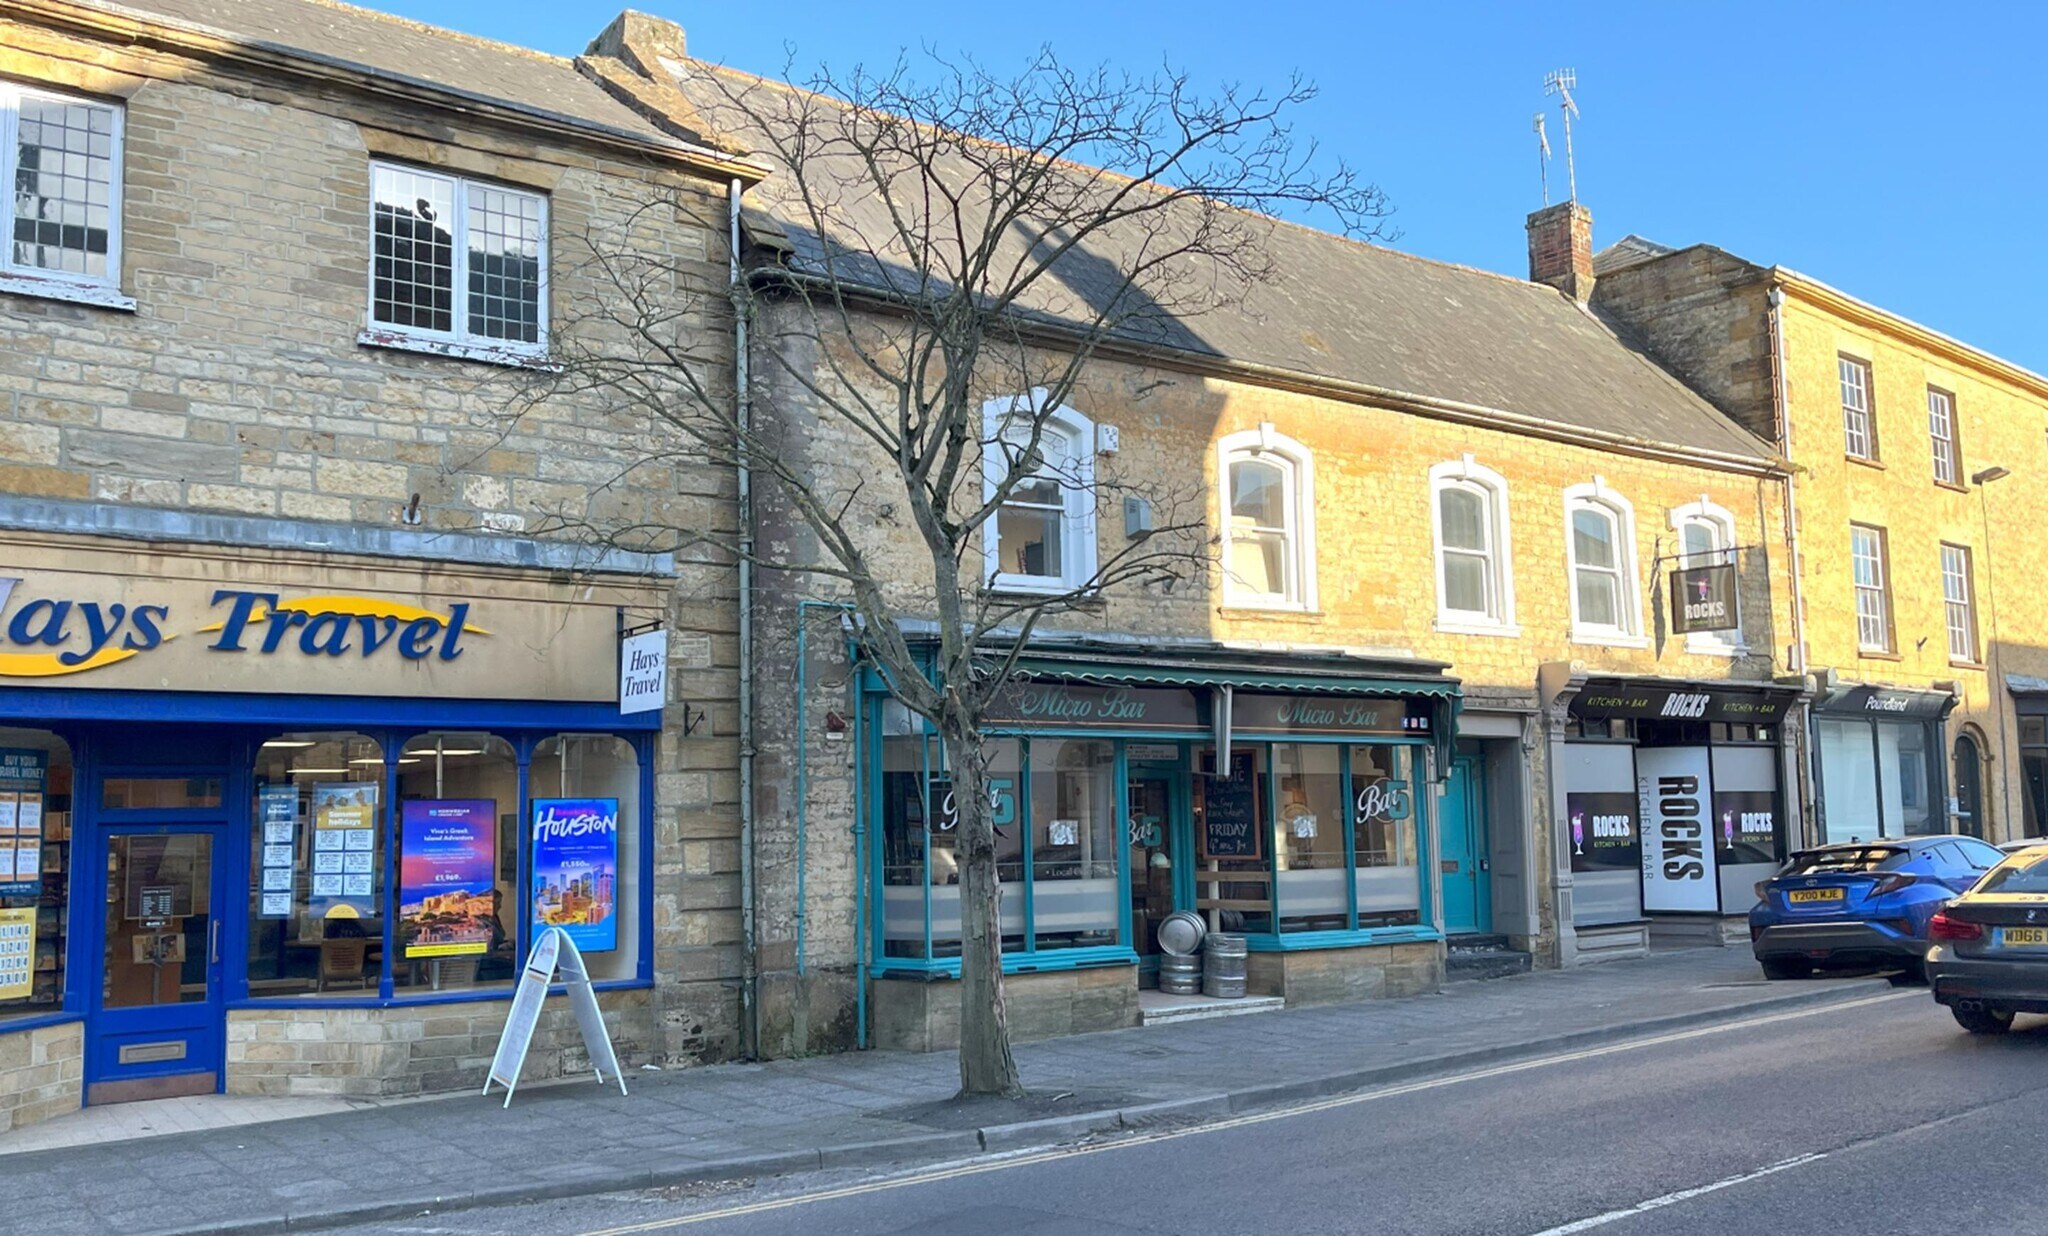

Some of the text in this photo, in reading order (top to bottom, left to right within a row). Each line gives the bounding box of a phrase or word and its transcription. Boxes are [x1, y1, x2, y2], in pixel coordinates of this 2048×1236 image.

[1684, 601, 1725, 620] ROCKS
[207, 589, 470, 662] Travel
[630, 649, 660, 673] Hays
[624, 671, 662, 697] Travel
[1020, 687, 1147, 719] Micro Bar
[1277, 699, 1380, 726] Micro Bar
[1586, 696, 1624, 707] KITCHEN
[1631, 698, 1649, 708] BAR
[1660, 692, 1711, 718] ROCKS
[1722, 702, 1754, 713] KITCHEN
[1760, 704, 1776, 713] BAR
[1865, 695, 1910, 712] Poundland
[1355, 780, 1410, 824] Bar 5
[1638, 776, 1651, 836] KITCHEN
[328, 817, 361, 827] holidays
[1142, 815, 1162, 847] 5
[1209, 823, 1248, 837] FRIDAY
[1592, 815, 1630, 838] ROCKS
[1657, 775, 1705, 881] ROCKS
[1741, 812, 1773, 833] ROCKS
[1643, 854, 1654, 880] BAR
[1793, 890, 1818, 901] Y200
[2005, 929, 2043, 942] WD66
